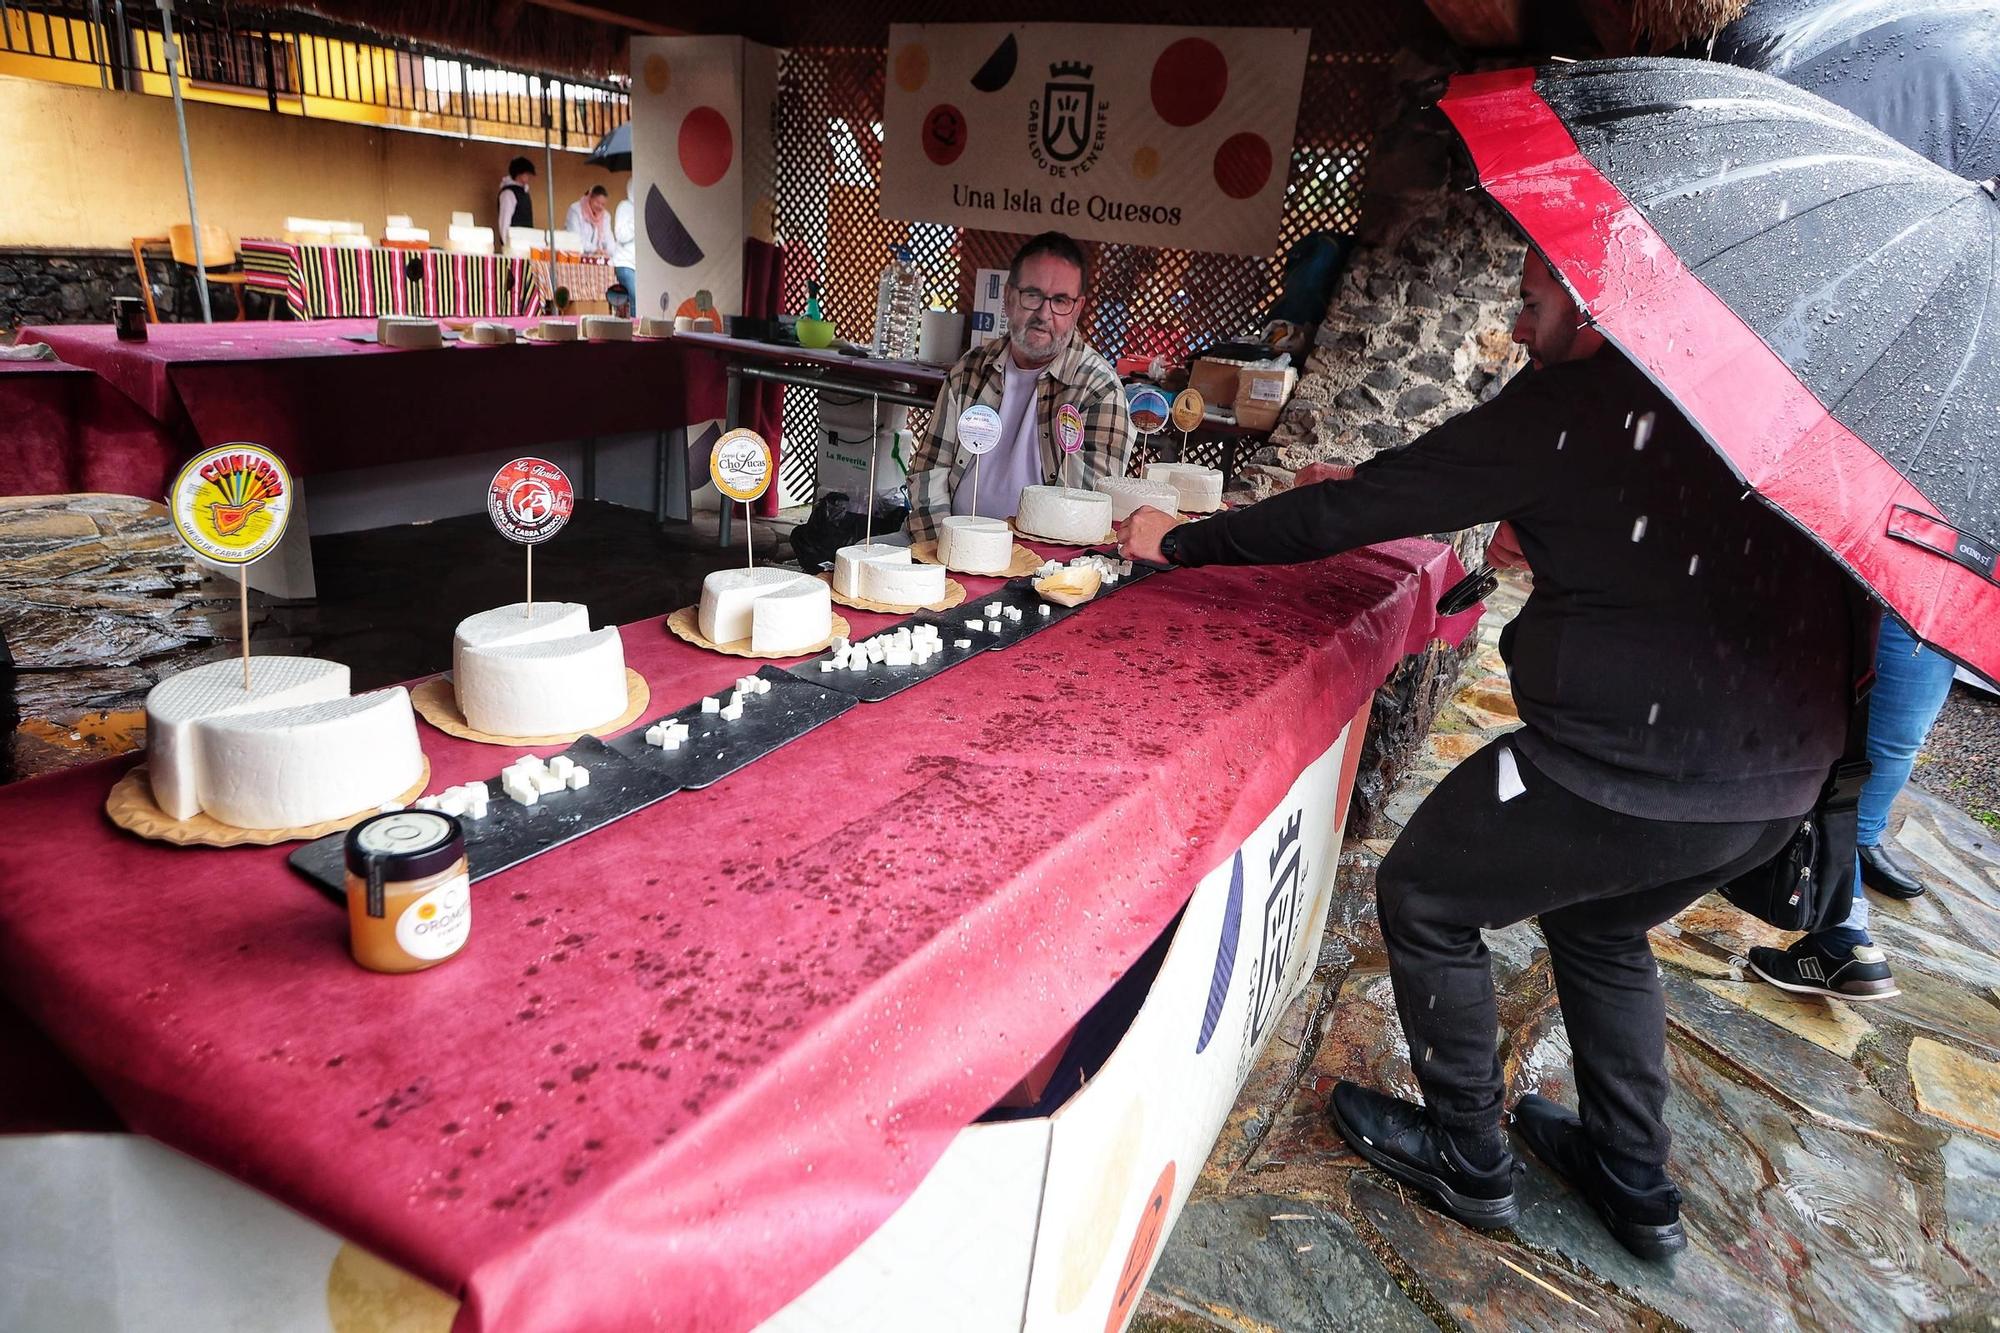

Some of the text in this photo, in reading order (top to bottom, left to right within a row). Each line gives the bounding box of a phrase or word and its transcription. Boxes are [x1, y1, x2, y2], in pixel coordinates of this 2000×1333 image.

[1028, 99, 1109, 178] CABILDO DE TENERIFE
[953, 184, 1182, 226] Una Isla de Quesos
[514, 461, 562, 481] La Florida
[826, 451, 835, 459] La
[496, 500, 562, 537] QUESO DE CABRA FRESCO
[183, 521, 203, 546] QUESO
[202, 542, 213, 552] DE
[214, 548, 243, 557] CABRA
